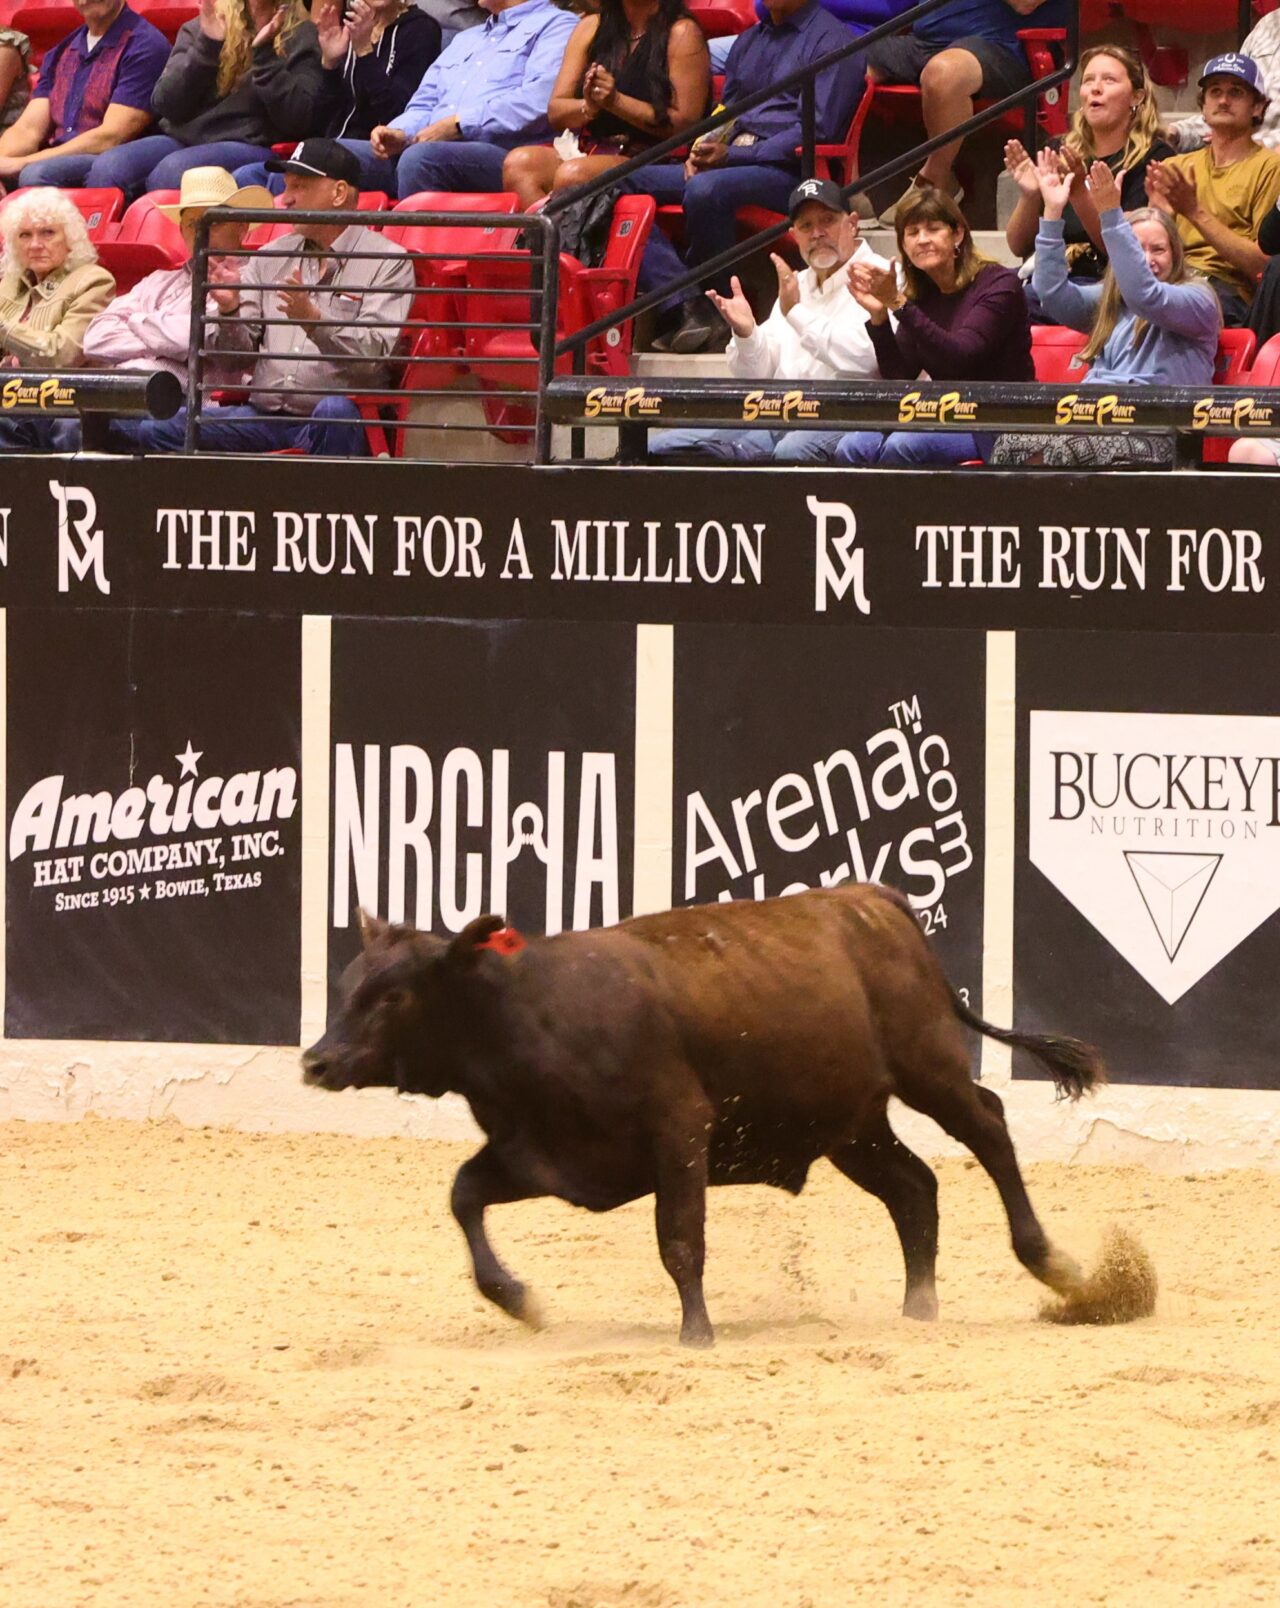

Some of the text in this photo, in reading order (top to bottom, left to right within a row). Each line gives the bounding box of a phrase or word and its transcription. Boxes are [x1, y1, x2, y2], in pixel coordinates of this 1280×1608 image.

[157, 508, 765, 584] THE RUN FOR A MILLION
[916, 525, 1020, 588] THE
[1039, 526, 1150, 590] RUN
[1167, 529, 1265, 593] FOR
[10, 767, 298, 862] American
[333, 743, 621, 939] NRCHA
[685, 728, 921, 900] Arena
[1090, 815, 1258, 839] NUTRITION
[33, 831, 285, 887] HAT COMPANY, INC.
[55, 871, 262, 912] SINCE 1915 BOWIE, TEXAS
